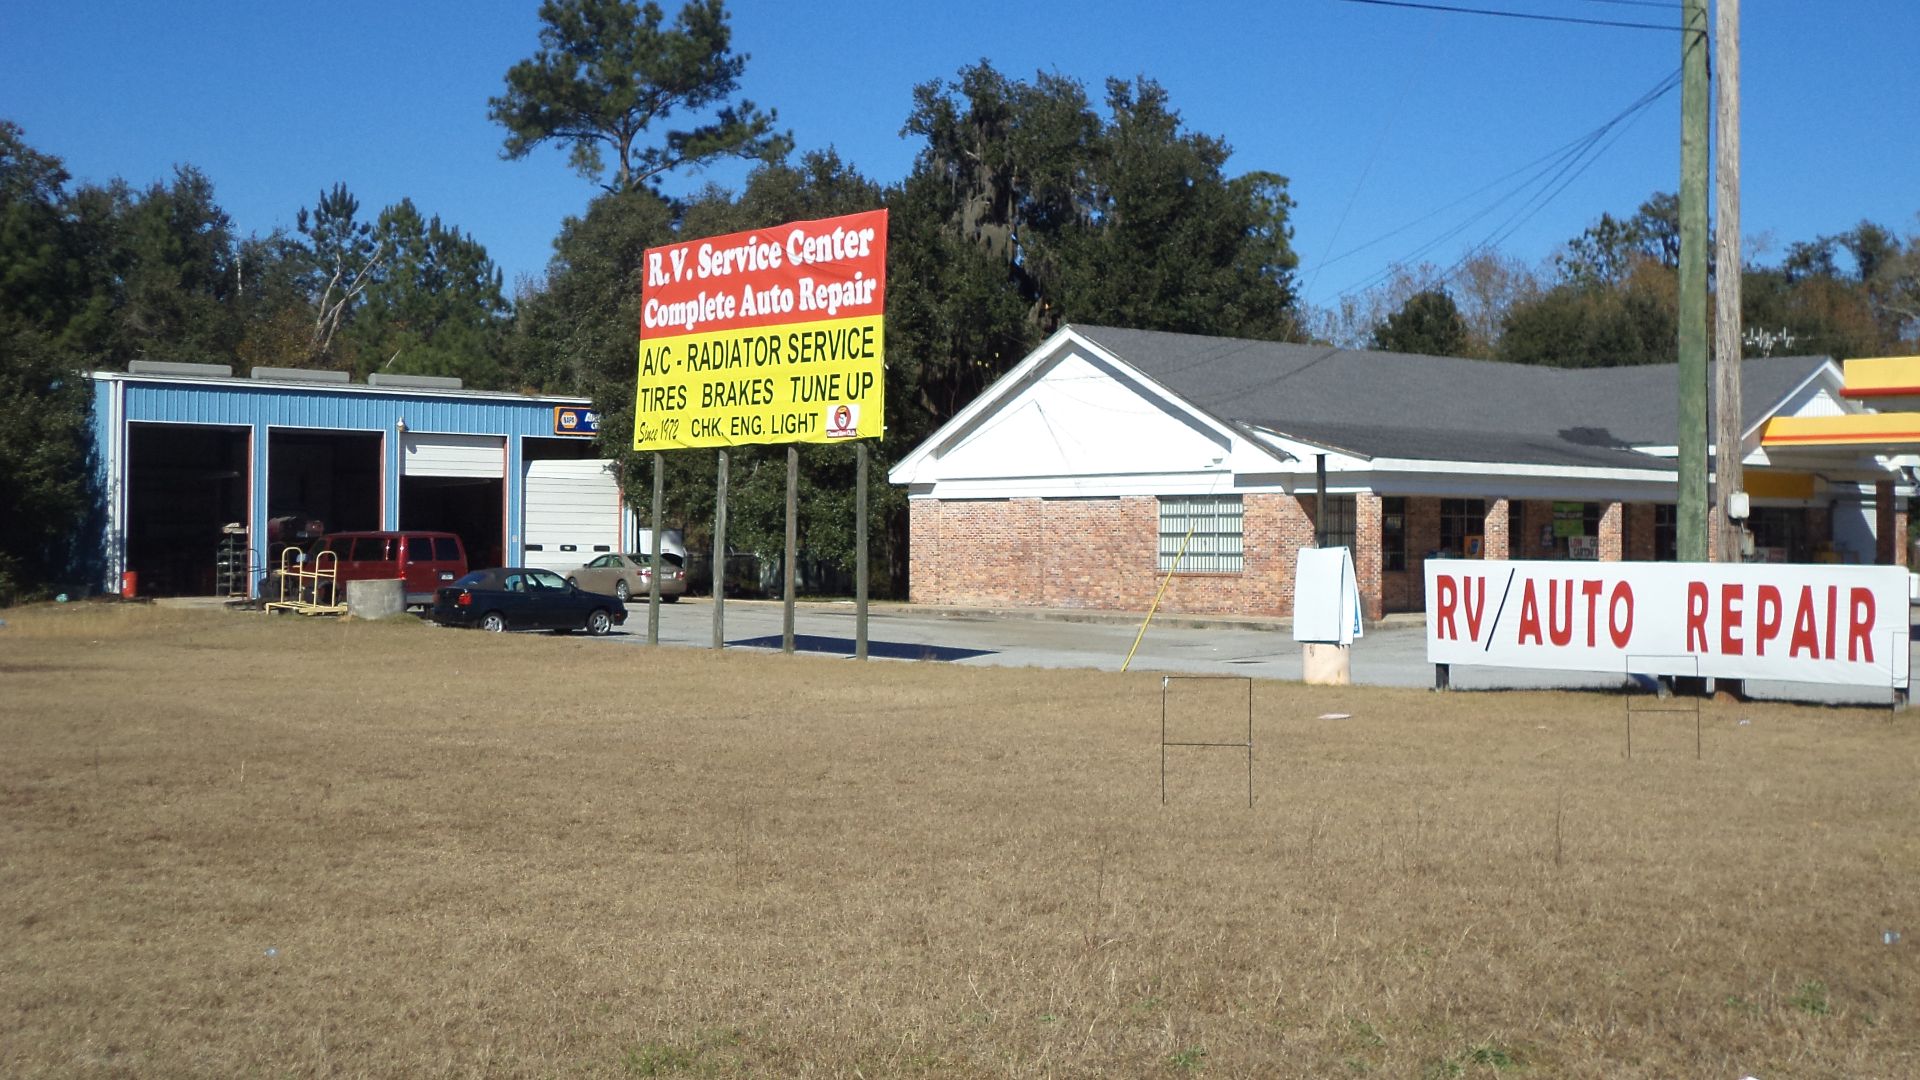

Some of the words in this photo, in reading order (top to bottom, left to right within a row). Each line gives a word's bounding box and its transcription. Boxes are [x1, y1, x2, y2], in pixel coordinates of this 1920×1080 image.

[648, 247, 693, 287] R.V.
[697, 236, 782, 279] Service
[786, 226, 875, 266] Center
[644, 292, 735, 330] Complete
[739, 284, 794, 317] Auto
[799, 271, 876, 315] Repair
[643, 346, 671, 377] A/C
[687, 336, 781, 372] RADIATOR
[788, 326, 875, 365] SERVICE
[641, 384, 687, 412] TIRES
[702, 378, 774, 408] BRAKES
[790, 374, 840, 403] TUNE
[846, 371, 874, 400] UP
[638, 420, 658, 444] Since
[660, 418, 680, 441] 1972
[691, 416, 725, 438] CHK.
[731, 415, 766, 436] ENG.
[771, 412, 818, 435] LIGHT
[1437, 567, 1635, 651] RV/AUTO
[1686, 581, 1876, 663] REPAIR
